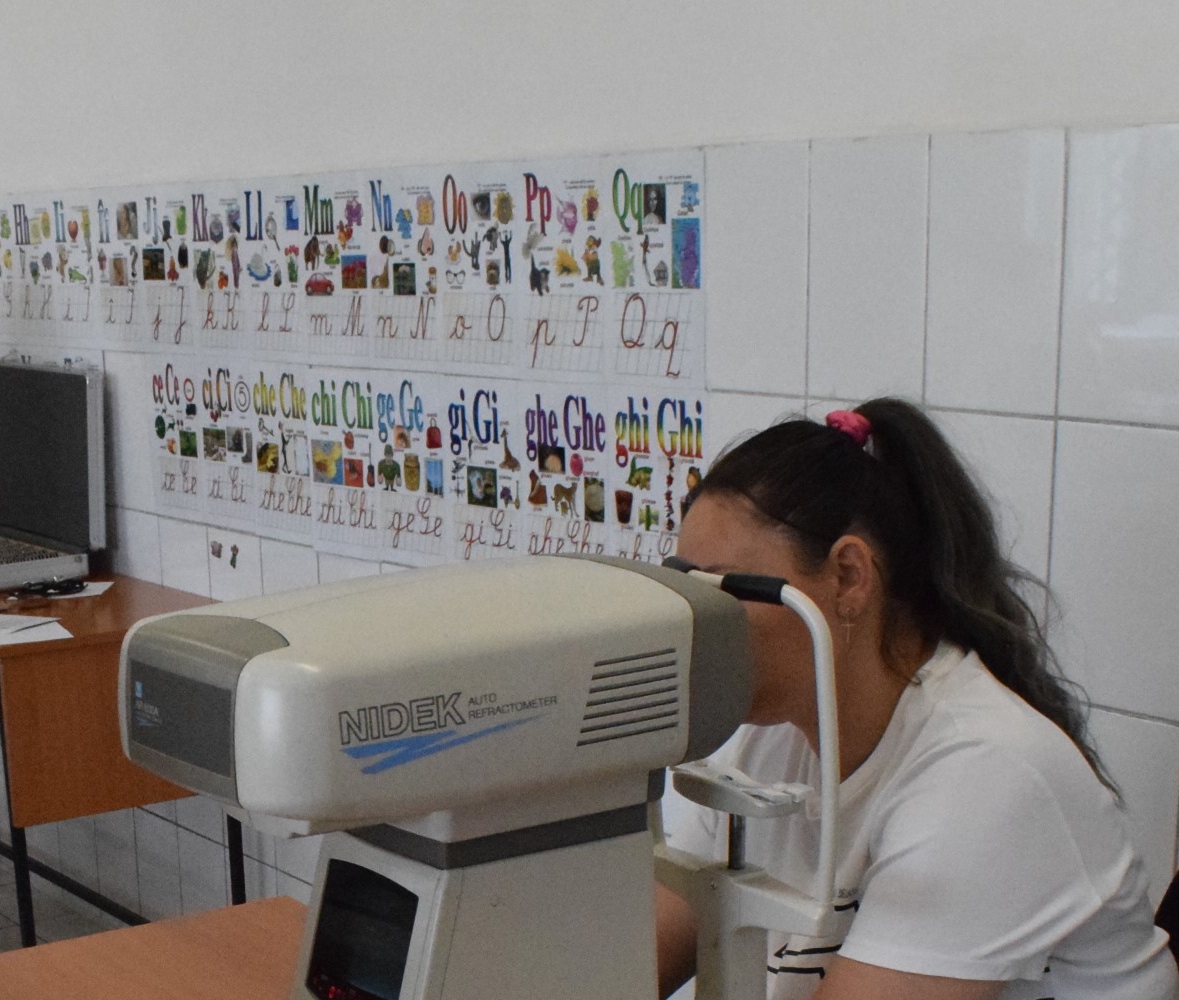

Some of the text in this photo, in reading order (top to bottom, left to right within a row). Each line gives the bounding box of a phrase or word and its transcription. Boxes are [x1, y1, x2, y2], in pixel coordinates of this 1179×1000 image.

[143, 196, 159, 245] Jj
[191, 193, 209, 242] Kk
[244, 190, 263, 241] Ll
[303, 184, 334, 236] Mm
[369, 179, 393, 232] Nn
[442, 174, 468, 235] Oo
[523, 172, 552, 236] Pp
[612, 168, 644, 235] Qq
[310, 296, 364, 336] m M
[377, 296, 436, 340] n N
[621, 293, 646, 348] Q
[152, 363, 180, 405] ce Ce
[202, 367, 232, 412] ci Ci
[238, 387, 246, 407] 5
[253, 371, 307, 420] che Che
[311, 380, 374, 429] chi Chi
[377, 379, 424, 443] ge Ge
[448, 388, 500, 455] gi Gi
[525, 393, 606, 461] ghe Ghe
[614, 396, 703, 468] ghi Ghi
[387, 510, 415, 548] ge
[460, 520, 486, 560] gi
[338, 692, 466, 745] NIDEK
[467, 693, 498, 707] AUTO
[467, 696, 558, 720] REFRACTOMETER
